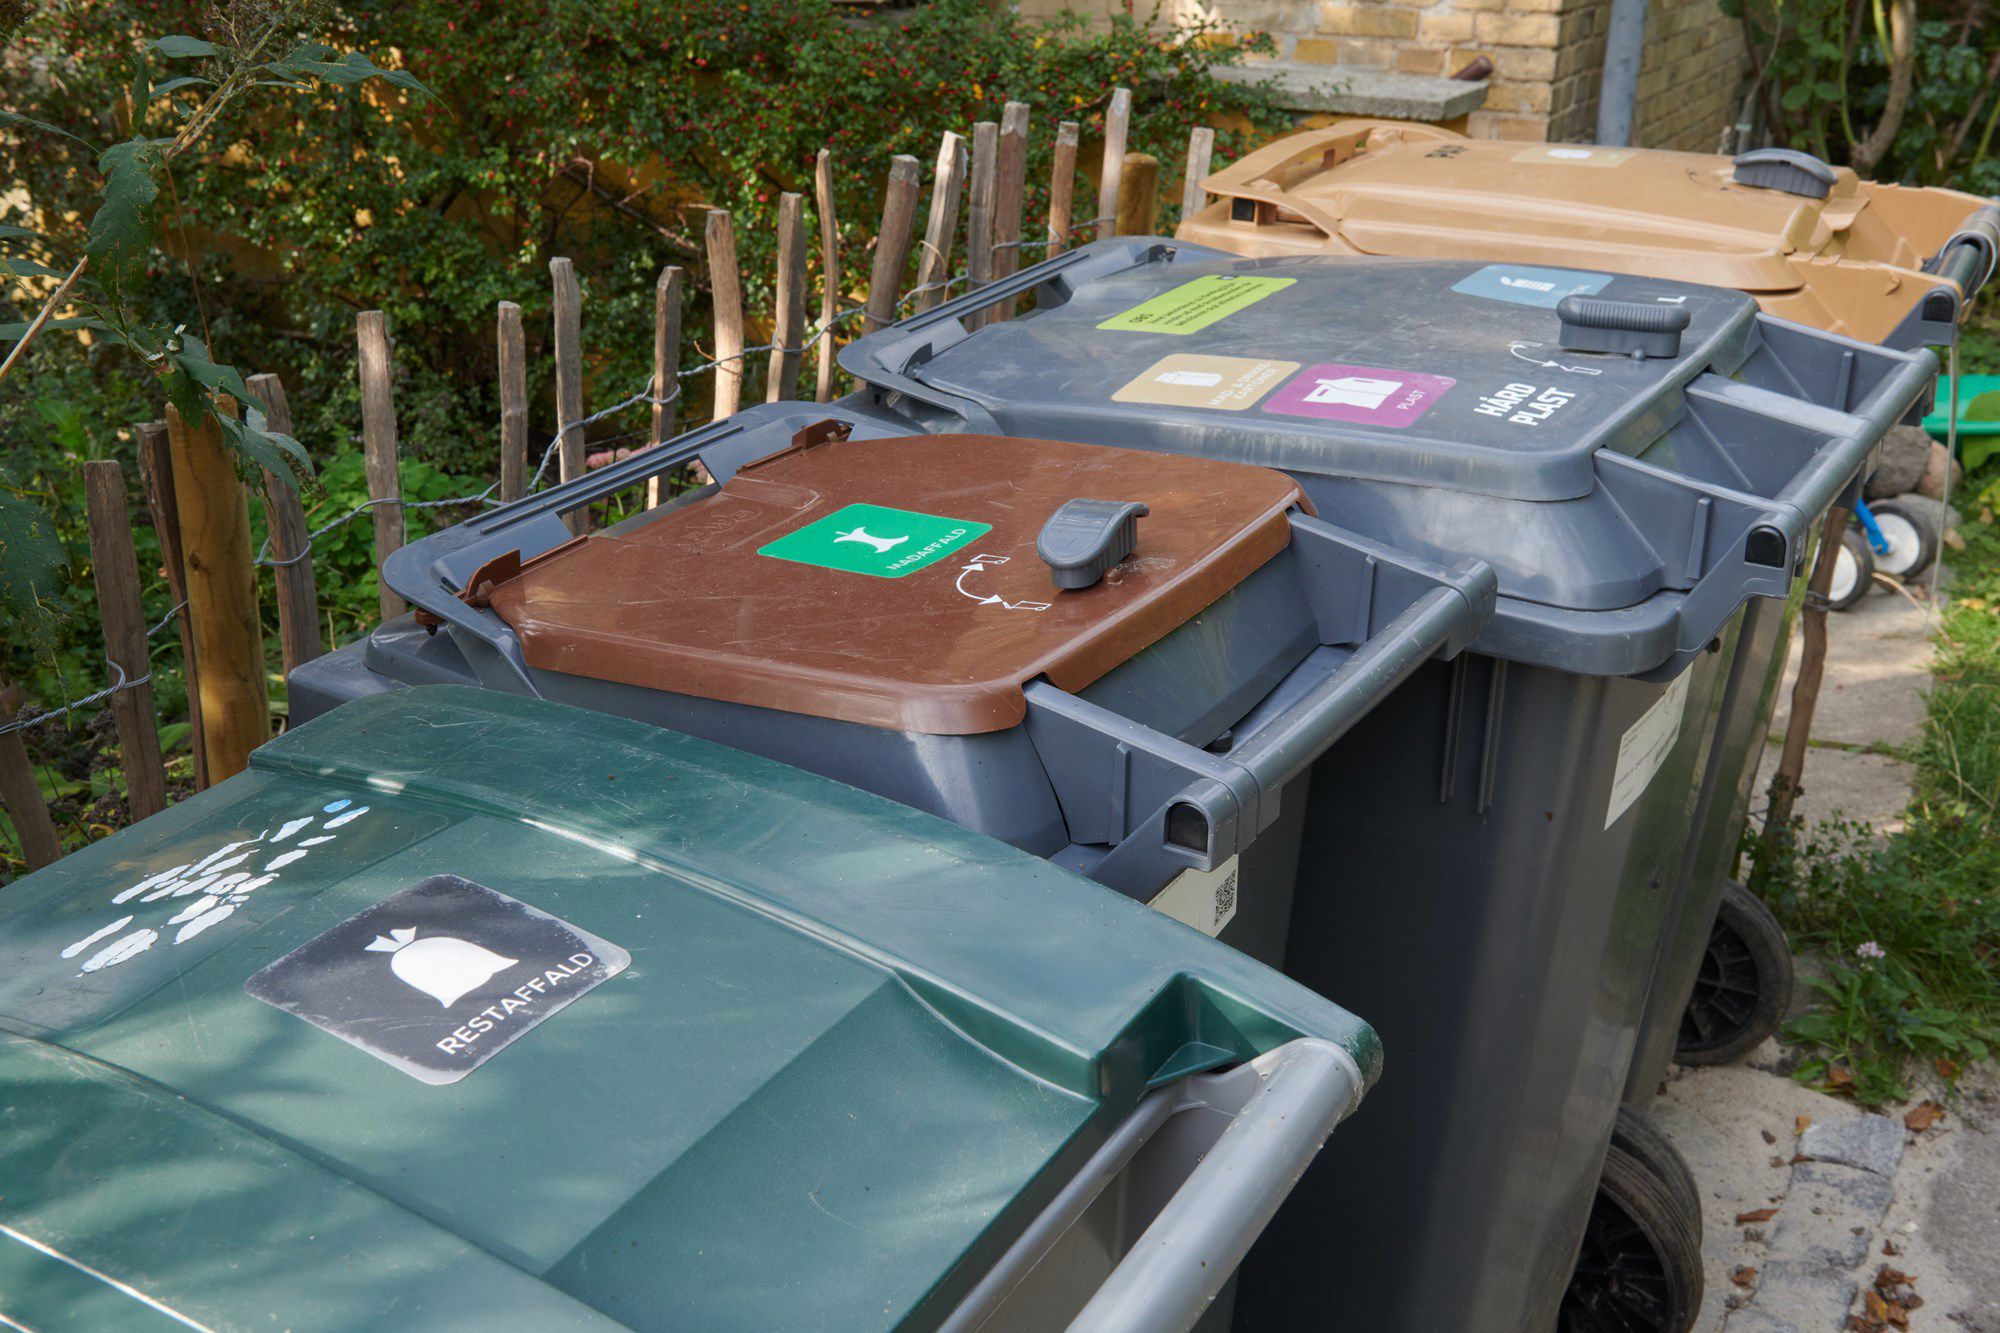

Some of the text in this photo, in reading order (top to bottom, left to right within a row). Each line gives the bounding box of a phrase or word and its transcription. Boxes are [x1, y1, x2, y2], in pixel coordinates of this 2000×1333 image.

[1397, 389, 1426, 410] PLAST
[1473, 383, 1537, 417] HÅRD
[1508, 387, 1576, 426] PLAST
[885, 528, 968, 571] MADAFFALD
[436, 952, 594, 1056] RESTAFFALD
